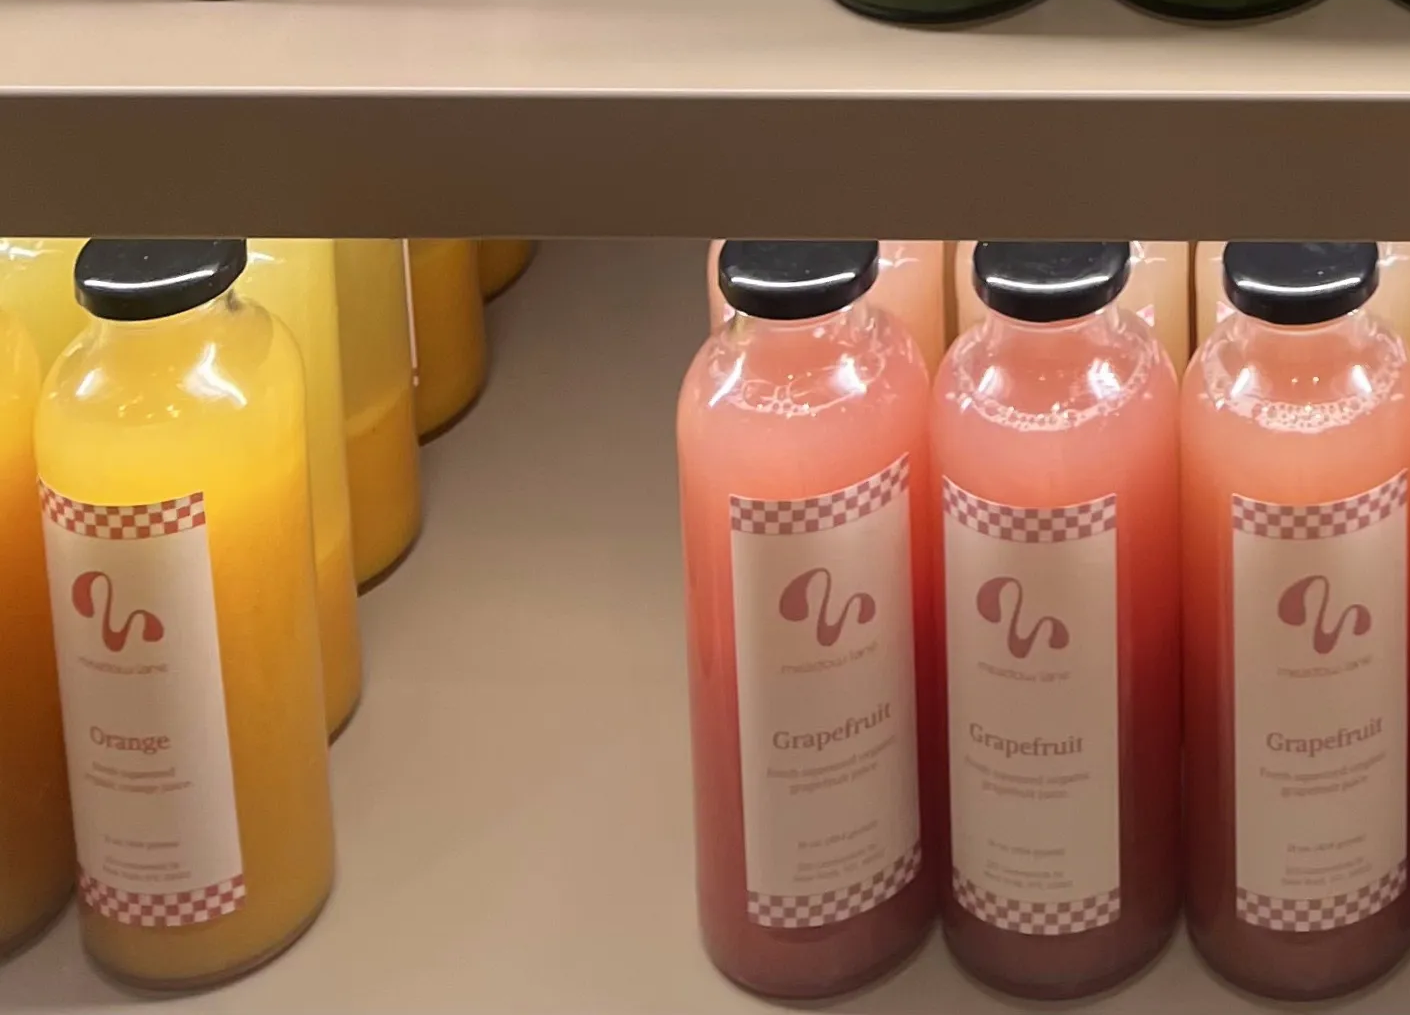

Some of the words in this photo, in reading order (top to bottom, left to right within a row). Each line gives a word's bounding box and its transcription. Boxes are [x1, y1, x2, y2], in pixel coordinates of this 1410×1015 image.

[90, 726, 171, 754] Orange
[773, 703, 891, 751] Grapefruit
[969, 723, 1083, 758] Grapefruit
[1266, 717, 1382, 758] Grapefruit
